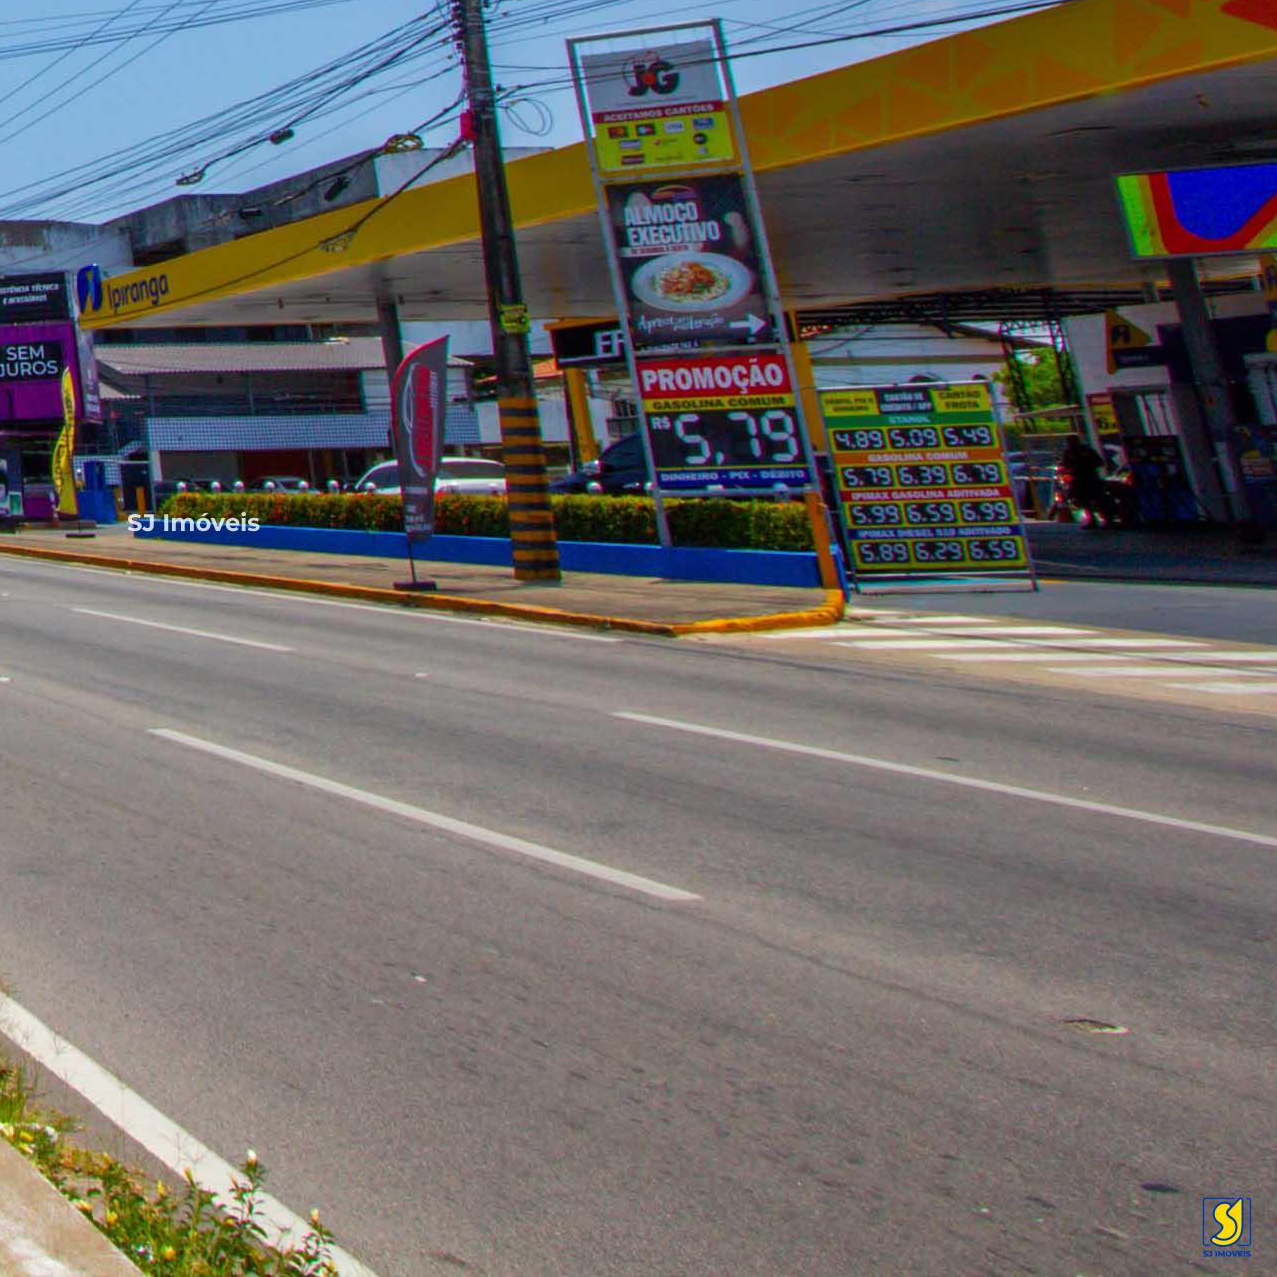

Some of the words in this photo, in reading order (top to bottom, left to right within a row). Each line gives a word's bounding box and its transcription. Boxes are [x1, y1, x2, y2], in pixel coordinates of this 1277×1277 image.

[627, 220, 722, 246] EXECUTIVO
[107, 273, 170, 315] Ipiranga
[5, 344, 45, 362] SEM
[641, 358, 784, 395] PROMOÇÃO
[652, 398, 725, 410] GASOLINA
[727, 395, 786, 408] COMUM
[650, 416, 671, 431] R$
[674, 410, 799, 466] 5,79
[835, 429, 885, 449] 4.89
[890, 427, 938, 447] 5.09
[944, 426, 991, 446] 5.49
[868, 453, 924, 462] GASOLINA
[927, 451, 969, 460] COMUM
[844, 467, 892, 486] 5.79
[897, 465, 945, 485] 6.39
[952, 464, 1000, 483] 6.79
[892, 490, 945, 500] GASOLINA
[947, 488, 1001, 498] ADITIVADA
[851, 504, 900, 523] 5.99
[906, 503, 955, 522] 6.59
[961, 502, 1009, 521] 6.99
[859, 543, 908, 562] 5.89
[915, 542, 962, 561] 6.29
[969, 540, 1017, 559] 6.59
